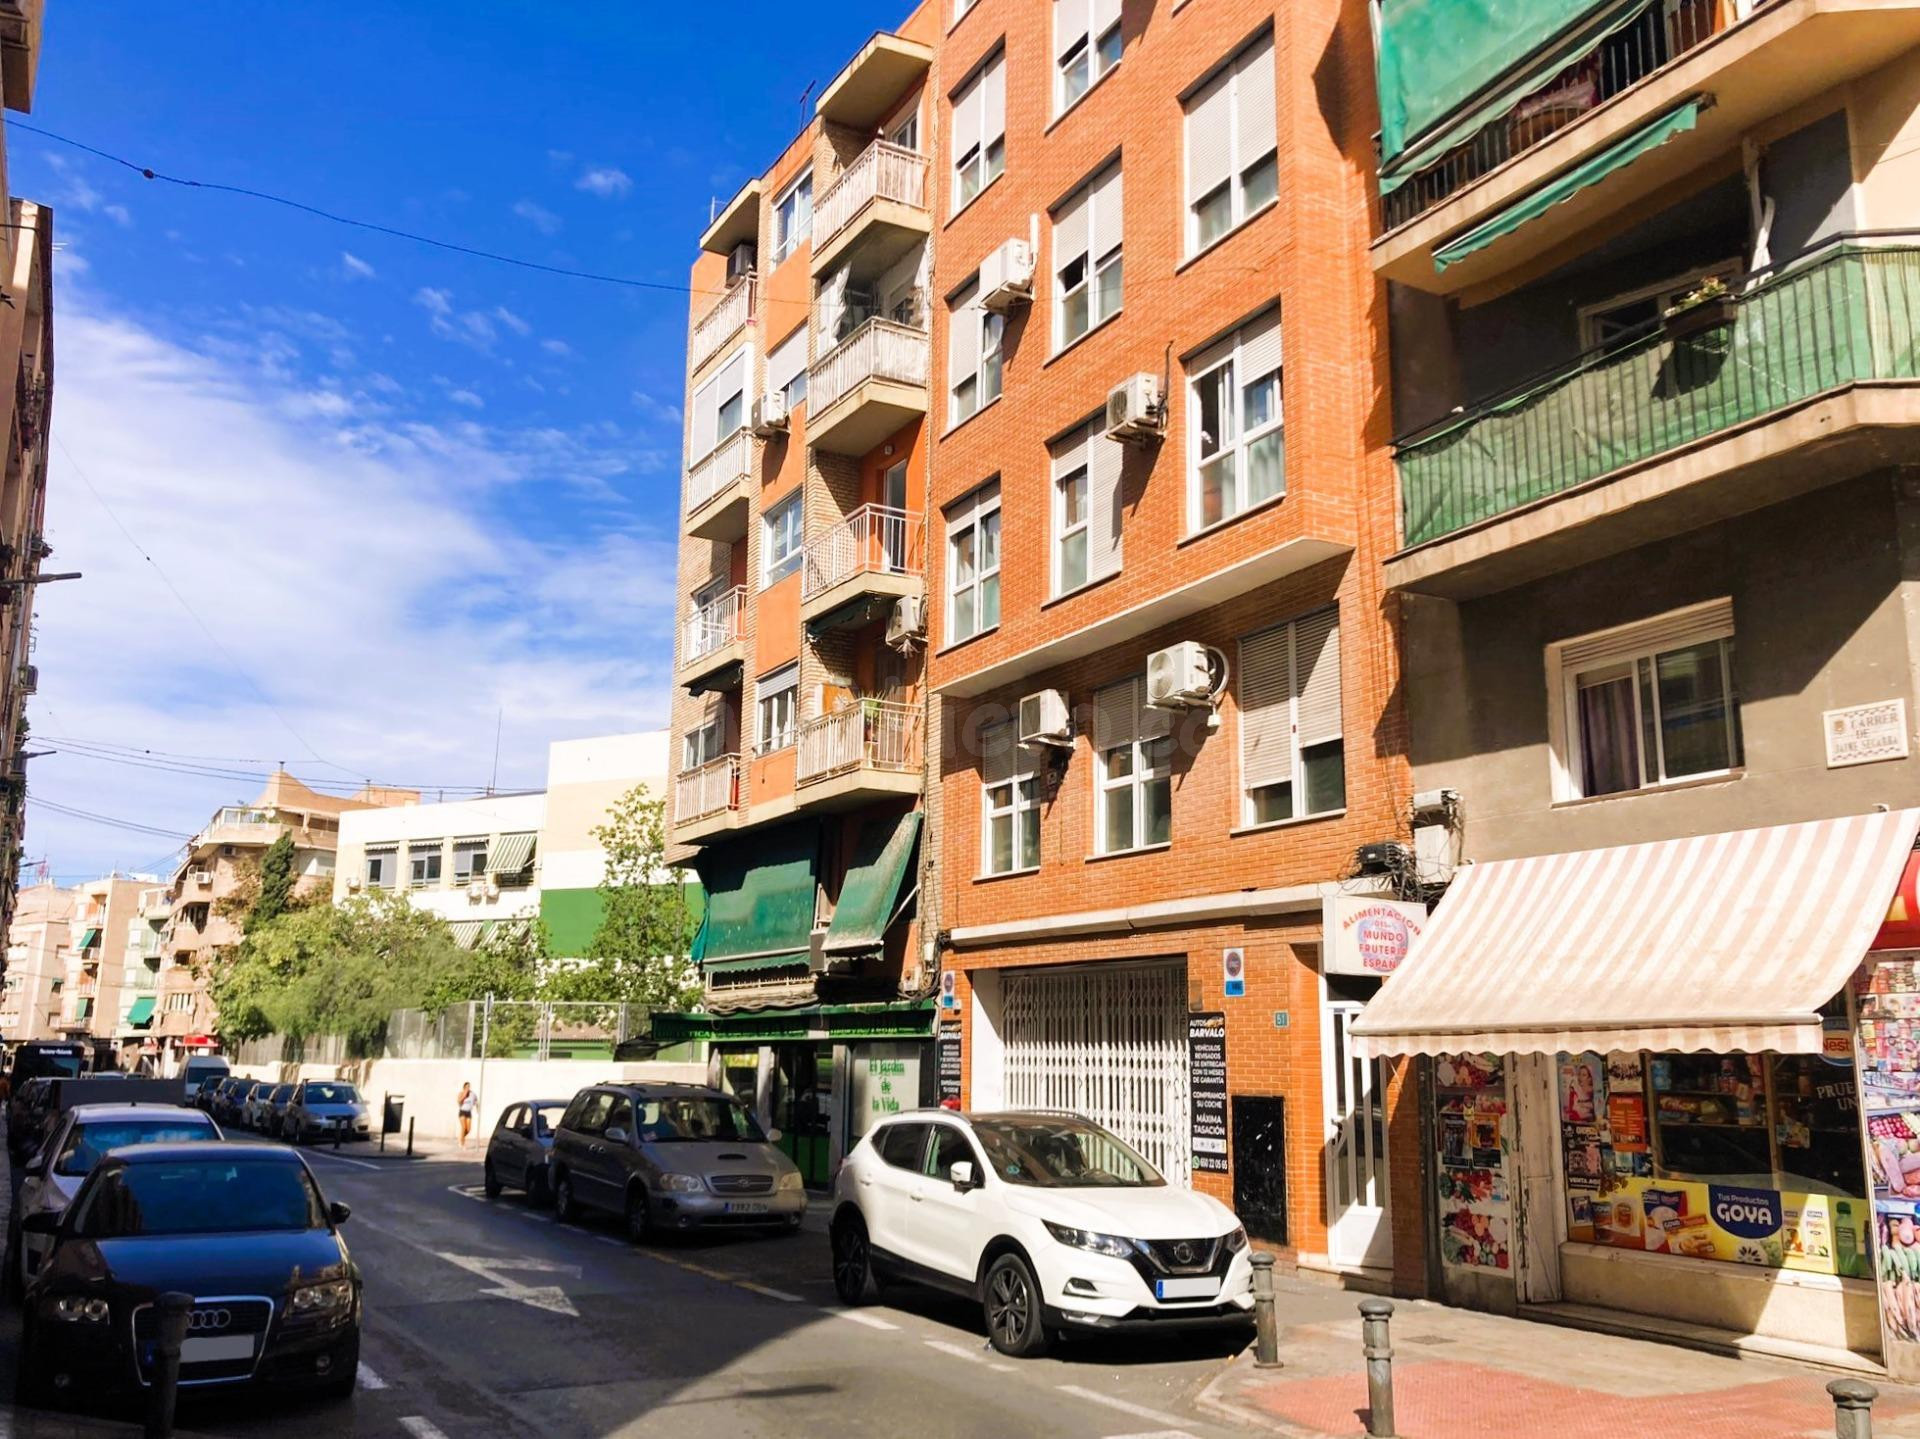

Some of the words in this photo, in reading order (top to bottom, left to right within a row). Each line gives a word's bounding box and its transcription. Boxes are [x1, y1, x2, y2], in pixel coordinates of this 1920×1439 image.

[1851, 712, 1899, 729] CARRER
[1856, 728, 1870, 739] DE
[1343, 907, 1421, 936] ALIMENTACION
[1363, 930, 1404, 942] MUNDO
[1277, 1012, 1286, 1027] 51
[1189, 1027, 1225, 1038] BARVALO
[1192, 1091, 1226, 1100] COMPRAMOS
[881, 1096, 900, 1111] Vida
[1204, 1101, 1222, 1109] COCHE
[1196, 1112, 1222, 1124] MÁXIMA
[1193, 1124, 1225, 1136] TASACIÓN
[1717, 1193, 1730, 1201] Tus
[1731, 1194, 1770, 1206] Productos
[1716, 1203, 1773, 1226] GOYA
